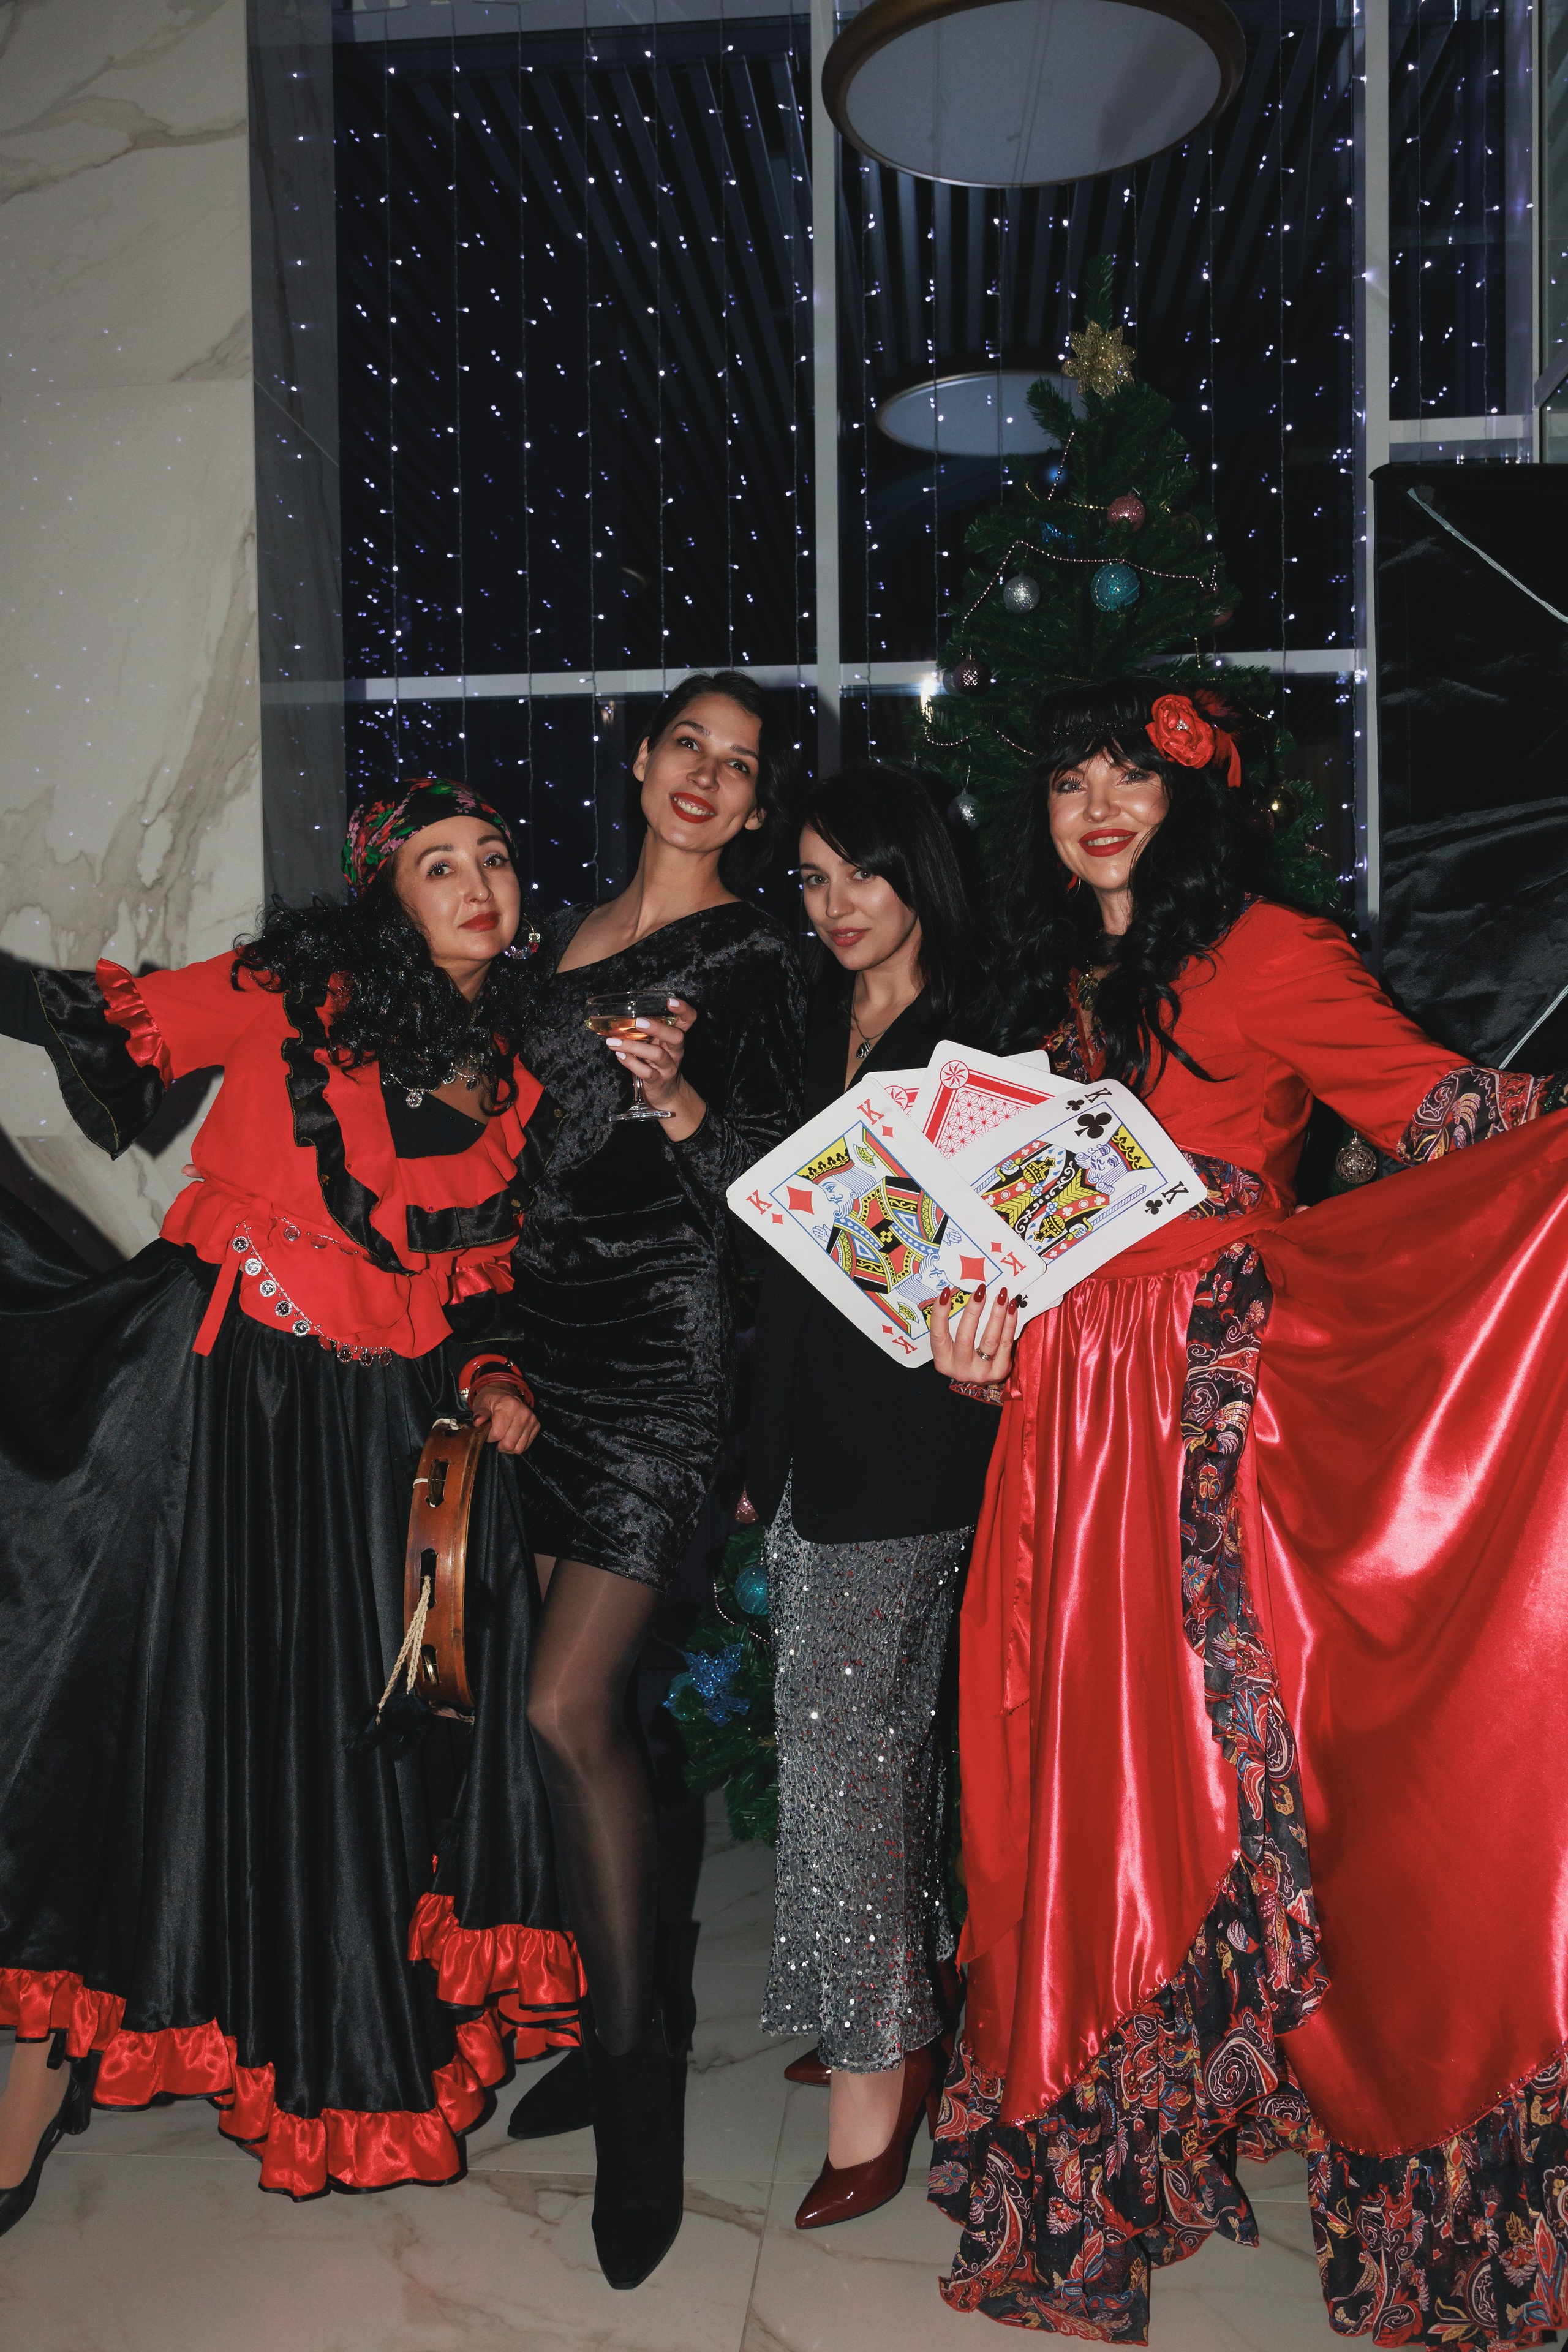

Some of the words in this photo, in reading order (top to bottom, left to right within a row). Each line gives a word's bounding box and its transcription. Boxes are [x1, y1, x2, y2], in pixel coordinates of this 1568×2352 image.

[1084, 1087, 1113, 1104] K
[857, 1099, 884, 1125] K
[746, 1189, 772, 1215] K
[1161, 1181, 1189, 1205] K
[1000, 1251, 1027, 1277] K
[891, 1335, 918, 1355] K
